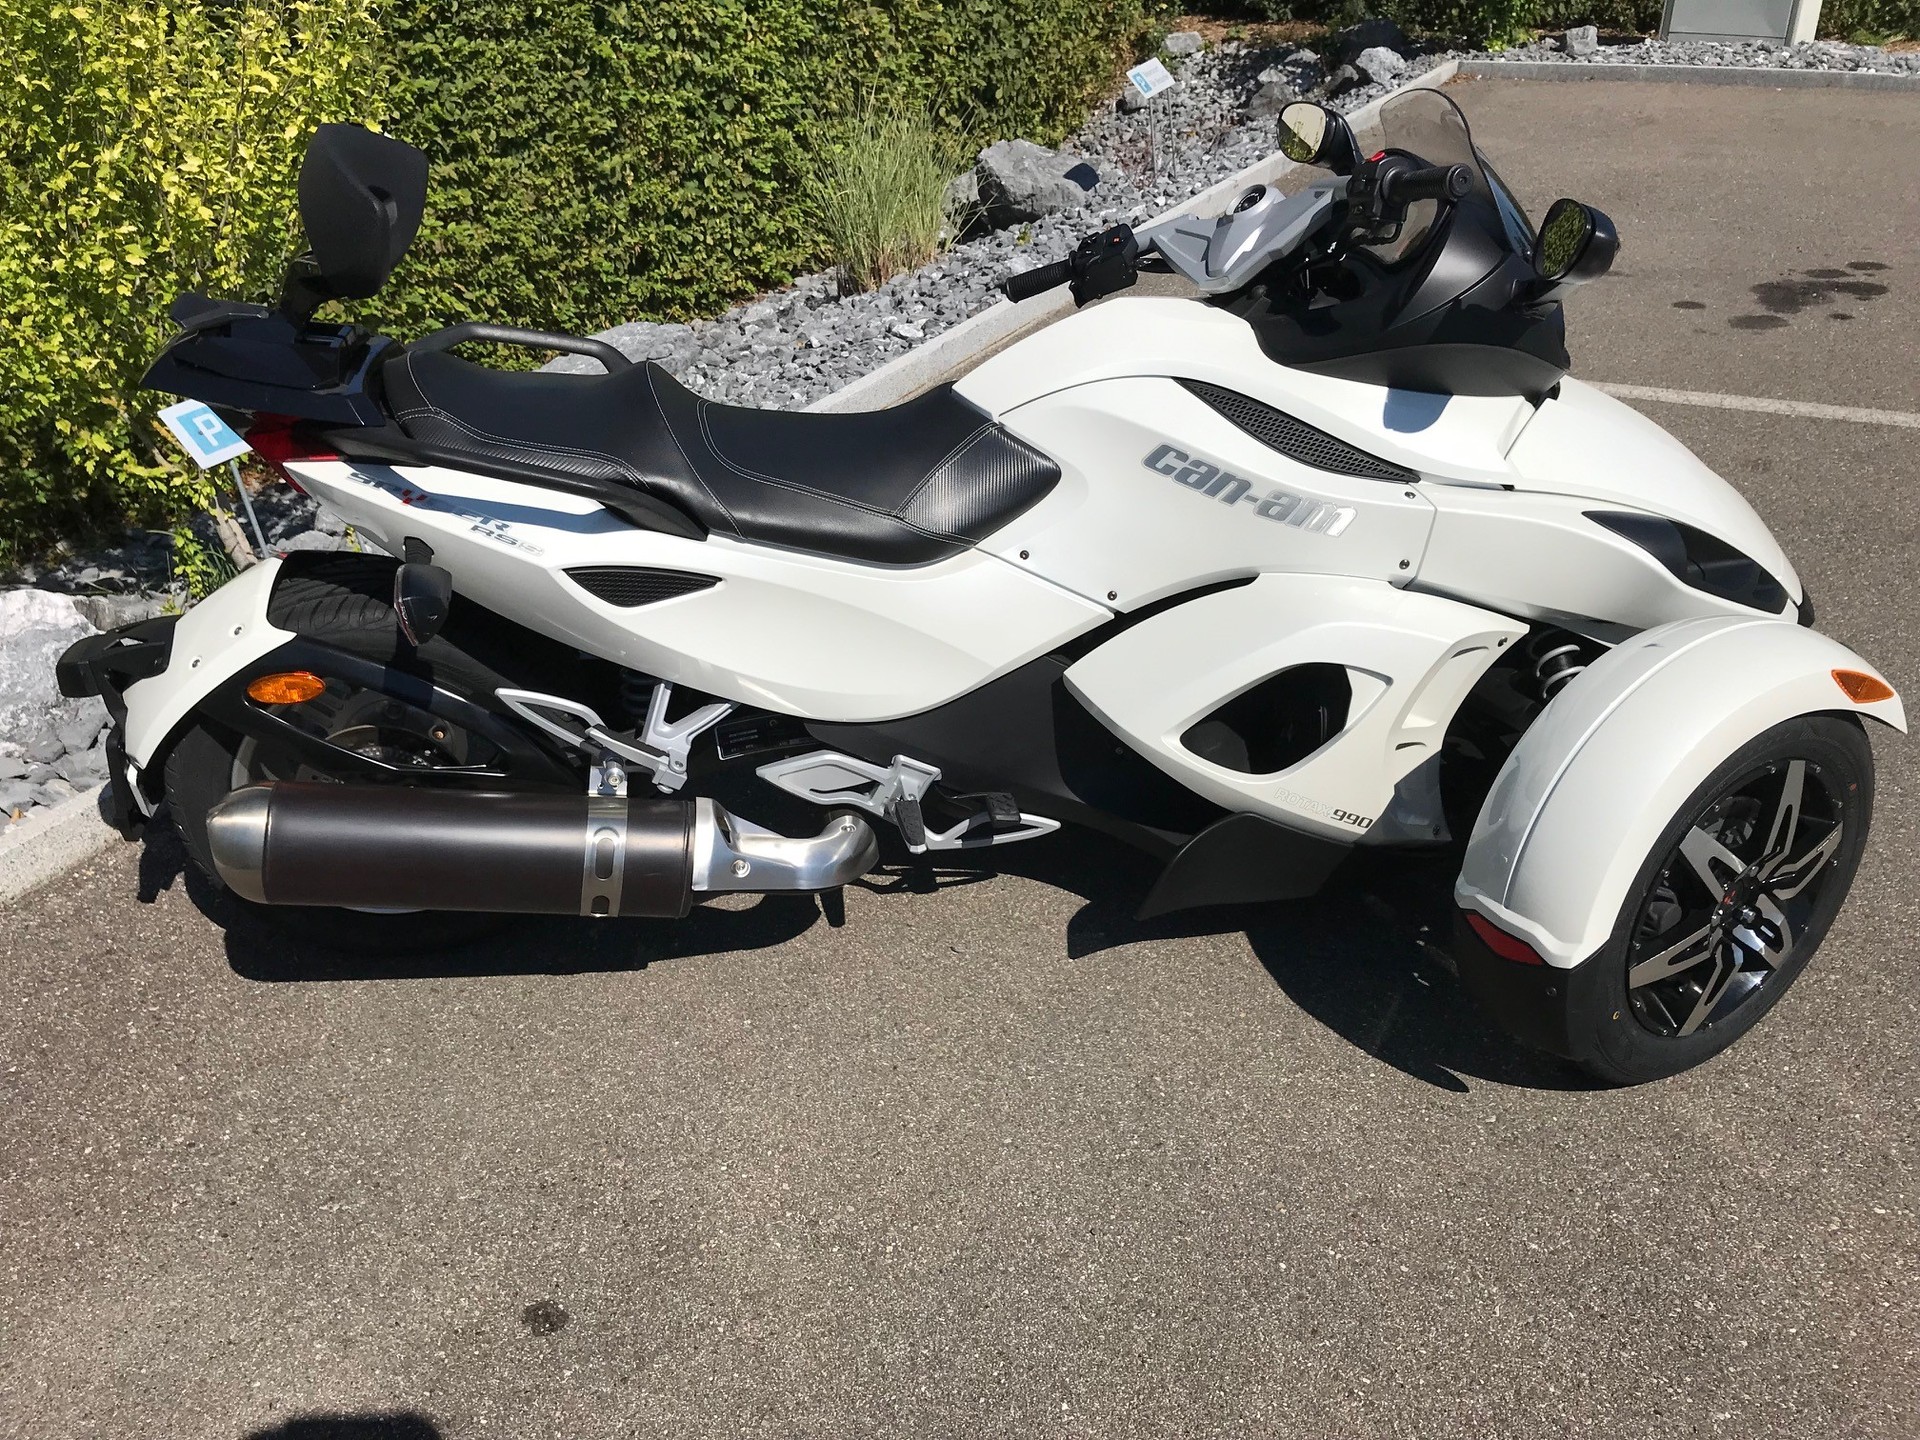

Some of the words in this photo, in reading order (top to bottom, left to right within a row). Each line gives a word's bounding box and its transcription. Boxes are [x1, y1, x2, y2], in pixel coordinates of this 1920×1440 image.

[192, 413, 222, 447] P
[1142, 443, 1357, 537] can-am
[1274, 787, 1333, 817] ROTAX
[1331, 809, 1374, 829] 990
